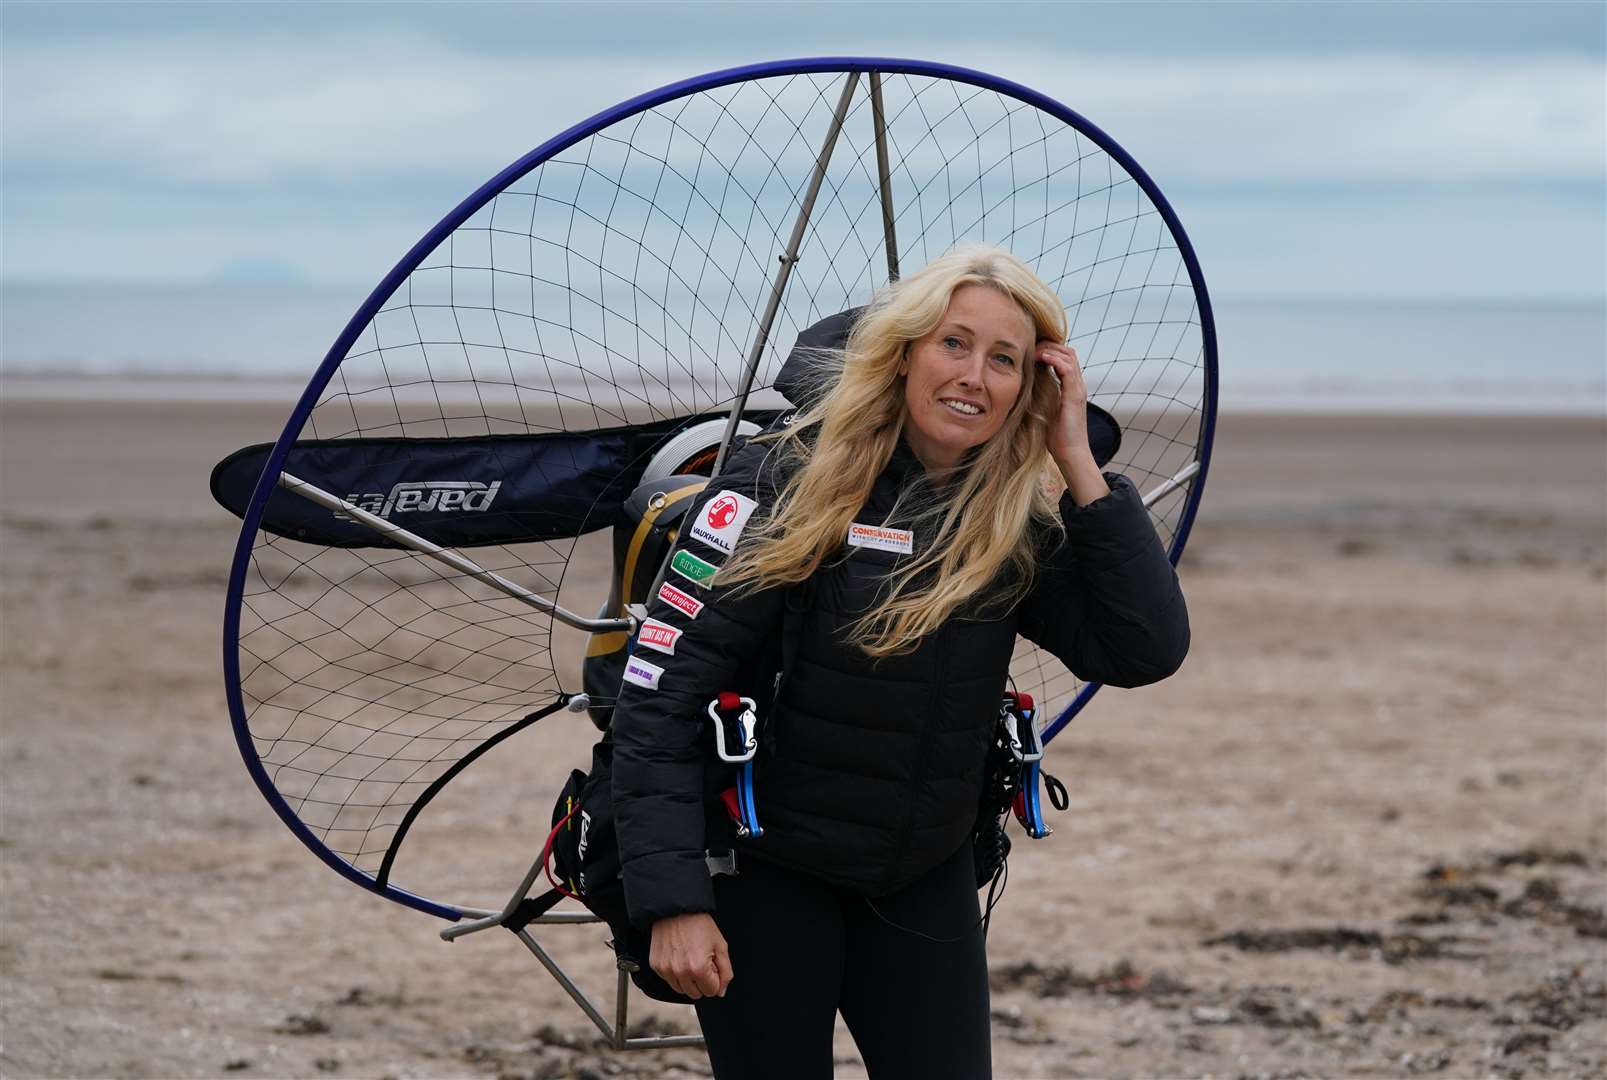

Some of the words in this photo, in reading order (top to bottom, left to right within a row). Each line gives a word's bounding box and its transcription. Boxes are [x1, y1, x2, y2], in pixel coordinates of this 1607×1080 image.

[334, 481, 502, 523] paraje
[693, 527, 730, 550] VAUXHALL
[852, 527, 910, 542] CONSERVATION
[679, 559, 703, 577] RIDGE
[671, 593, 697, 611] project
